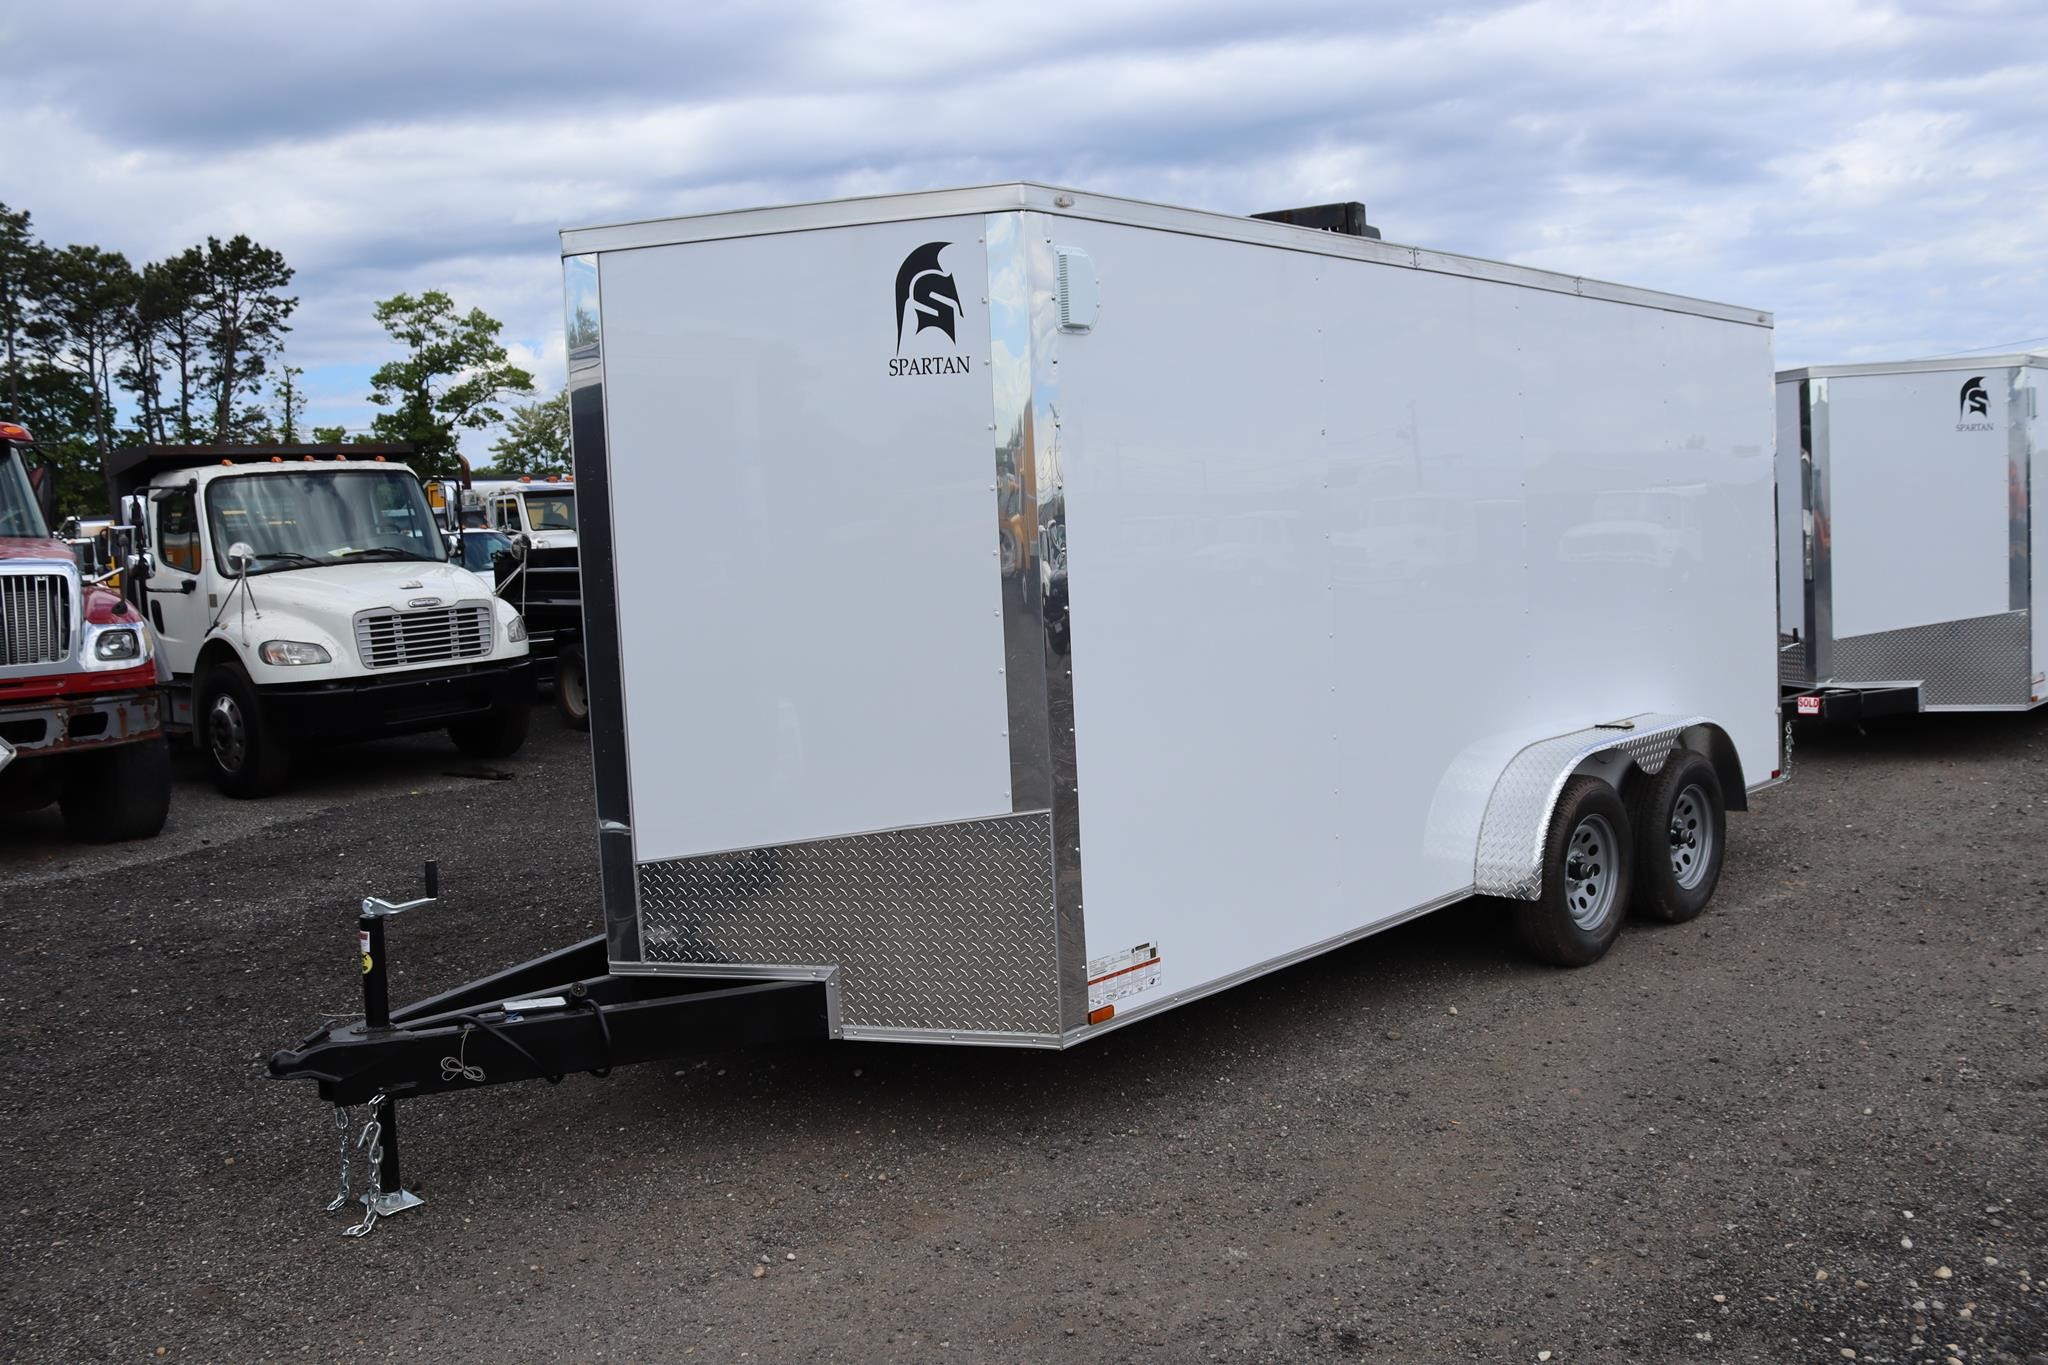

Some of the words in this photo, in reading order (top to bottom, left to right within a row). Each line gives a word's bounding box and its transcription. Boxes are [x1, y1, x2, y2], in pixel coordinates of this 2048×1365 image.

[889, 356, 970, 376] SPARTAN
[1955, 423, 1995, 432] SPARTAN
[1798, 698, 1819, 708] SOLD
